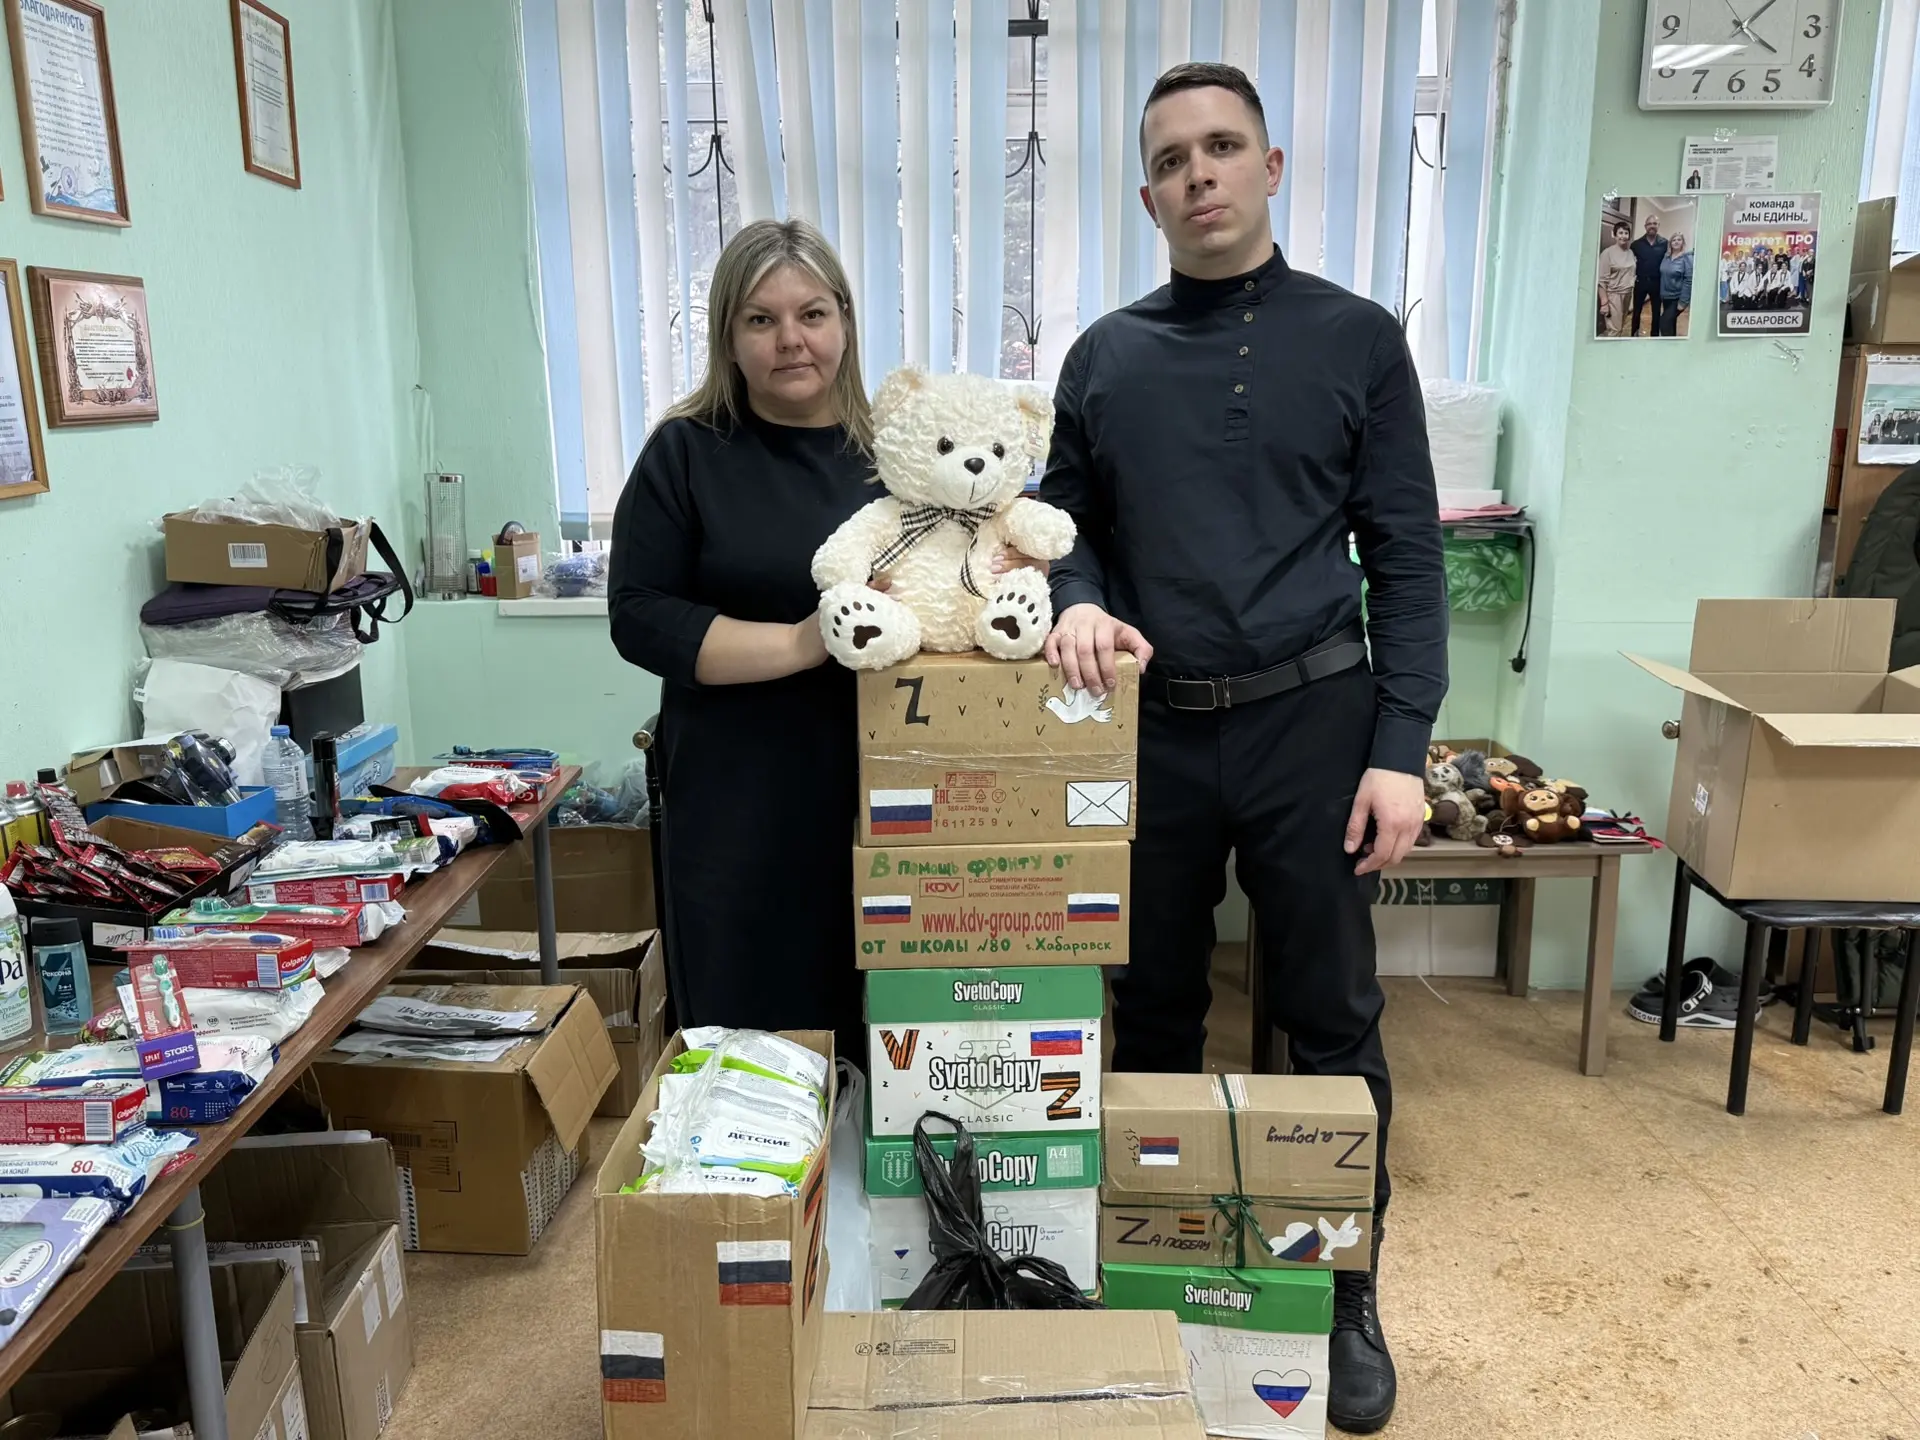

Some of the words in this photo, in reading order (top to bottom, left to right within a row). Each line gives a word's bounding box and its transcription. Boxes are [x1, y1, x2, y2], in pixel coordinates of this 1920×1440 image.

[1661, 14, 1681, 39] 9
[1803, 14, 1821, 38] 3
[1798, 54, 1816, 78] 4
[1692, 69, 1709, 93] 7
[1727, 69, 1746, 93] 6
[1762, 69, 1781, 93] 5
[1749, 200, 1795, 209] команда
[1727, 235, 1783, 248] Квартет
[1785, 234, 1814, 245] ПРО
[1730, 314, 1799, 326] #ХАБАРОВСК
[869, 852, 891, 878] В
[925, 882, 960, 893] KDV
[921, 906, 1065, 939] www.kdv-group.com
[281, 954, 307, 969] Colgate
[952, 980, 1024, 1005] SvetoCopy
[144, 1051, 161, 1064] SPLAT
[929, 1056, 1041, 1092] SvetoCopy
[116, 1106, 139, 1120] Colgate
[169, 1107, 189, 1119] 80
[957, 1114, 1014, 1124] CLASSIC
[727, 1132, 791, 1147] ДЕТСКИЕ
[1049, 1147, 1068, 1159] A4
[71, 1160, 94, 1174] 80
[1184, 1283, 1253, 1312] SvetoCopy
[1203, 1310, 1235, 1318] CLASSIC
